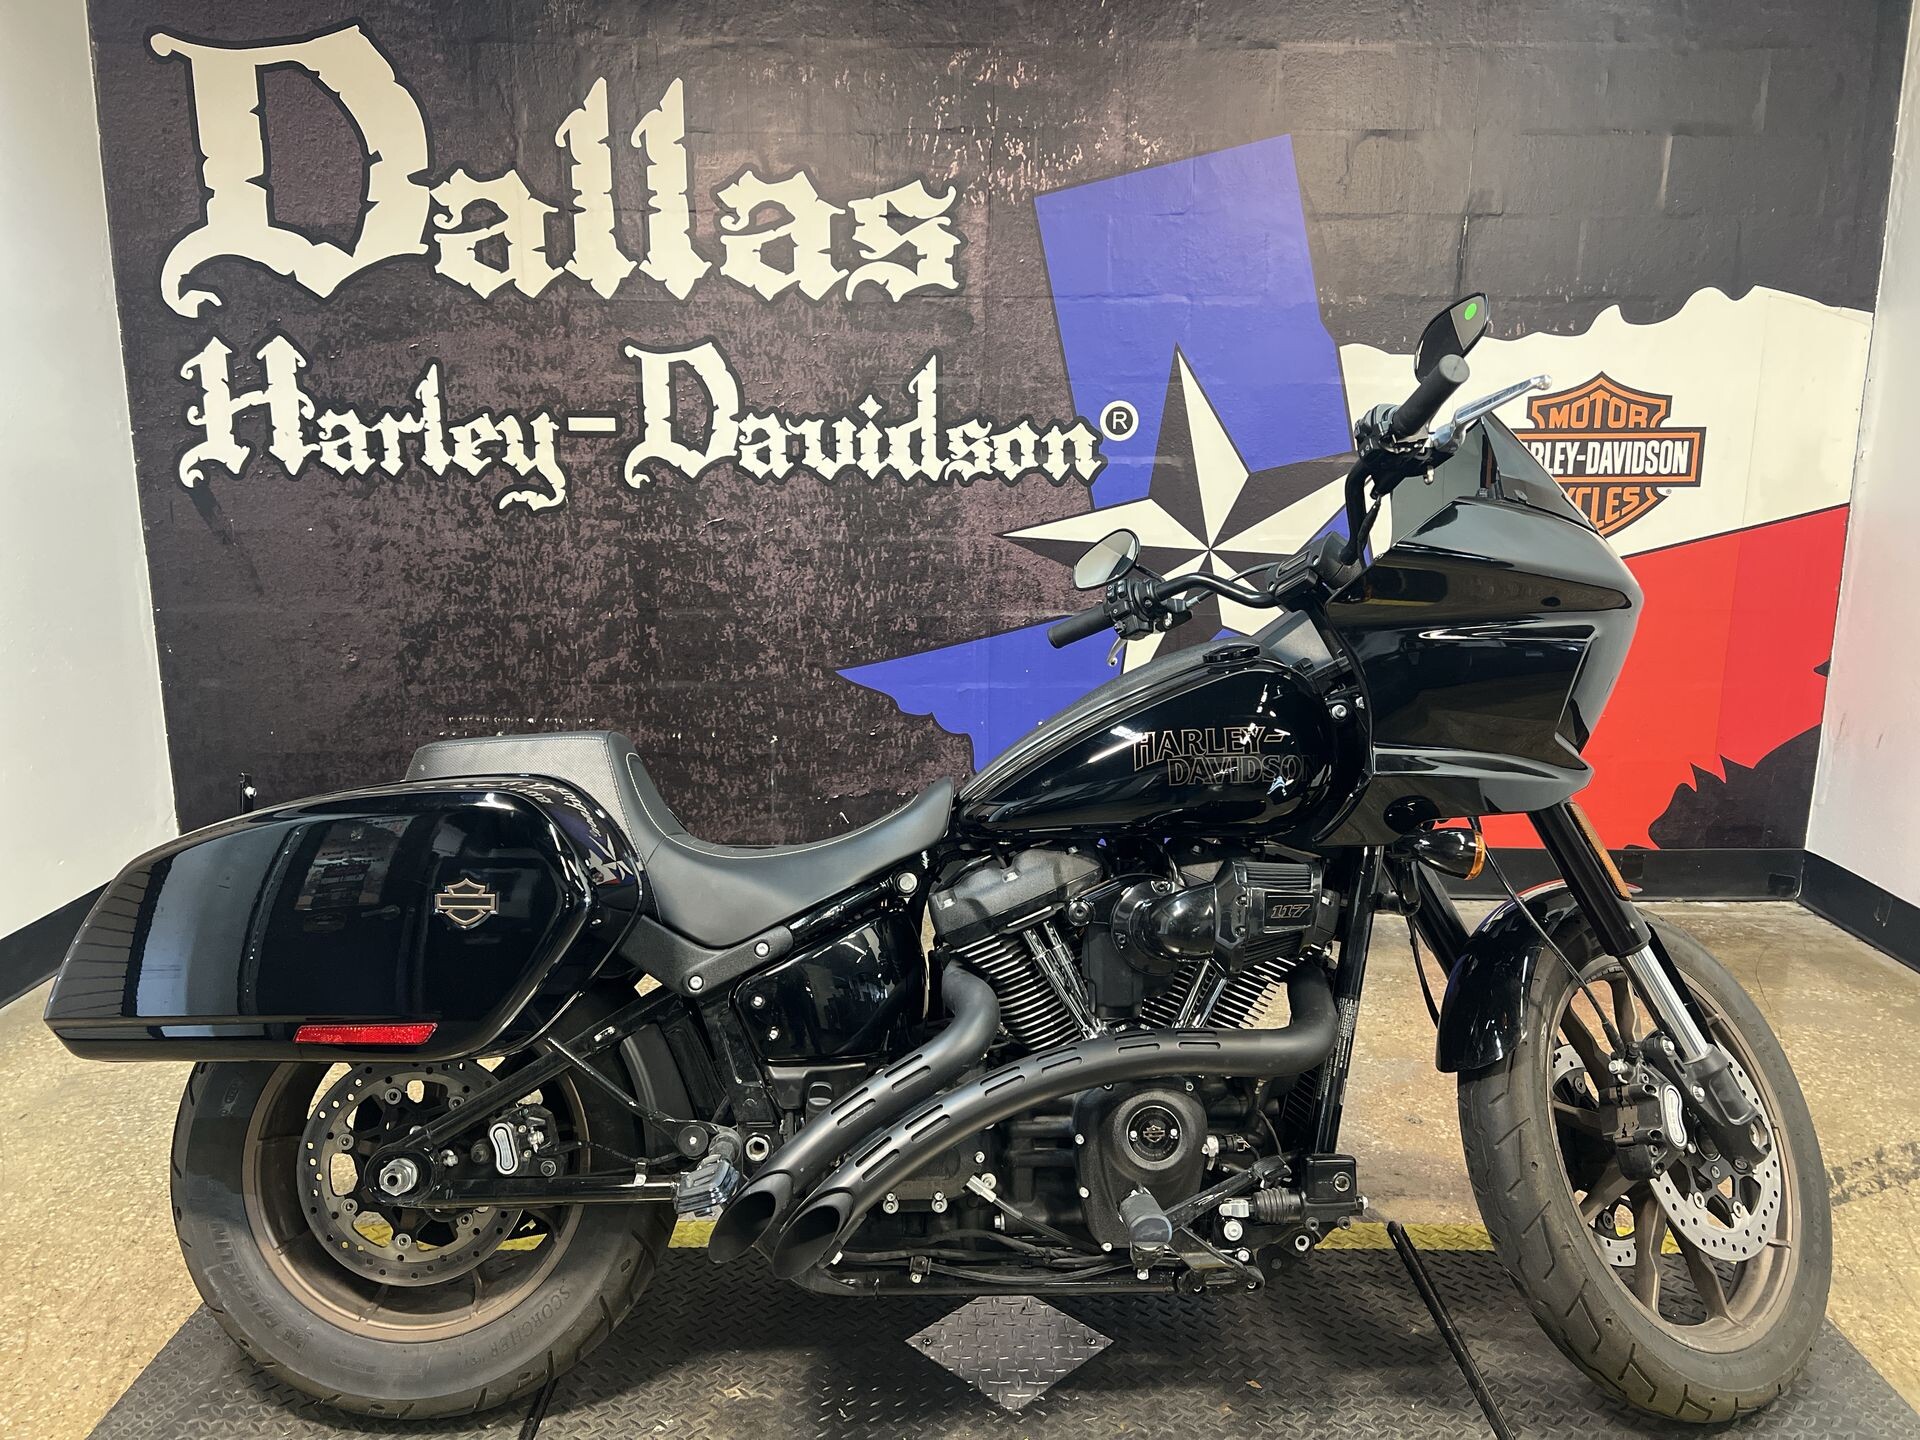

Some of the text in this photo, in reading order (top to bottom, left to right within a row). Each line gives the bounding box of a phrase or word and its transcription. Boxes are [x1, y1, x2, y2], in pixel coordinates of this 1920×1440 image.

[150, 25, 962, 318] Dallas
[178, 335, 1102, 510] Harley-Davidson
[1549, 389, 1649, 429] MOTOR
[1522, 440, 1690, 475] RLEY-DAVIDSON
[1270, 904, 1311, 919] 117
